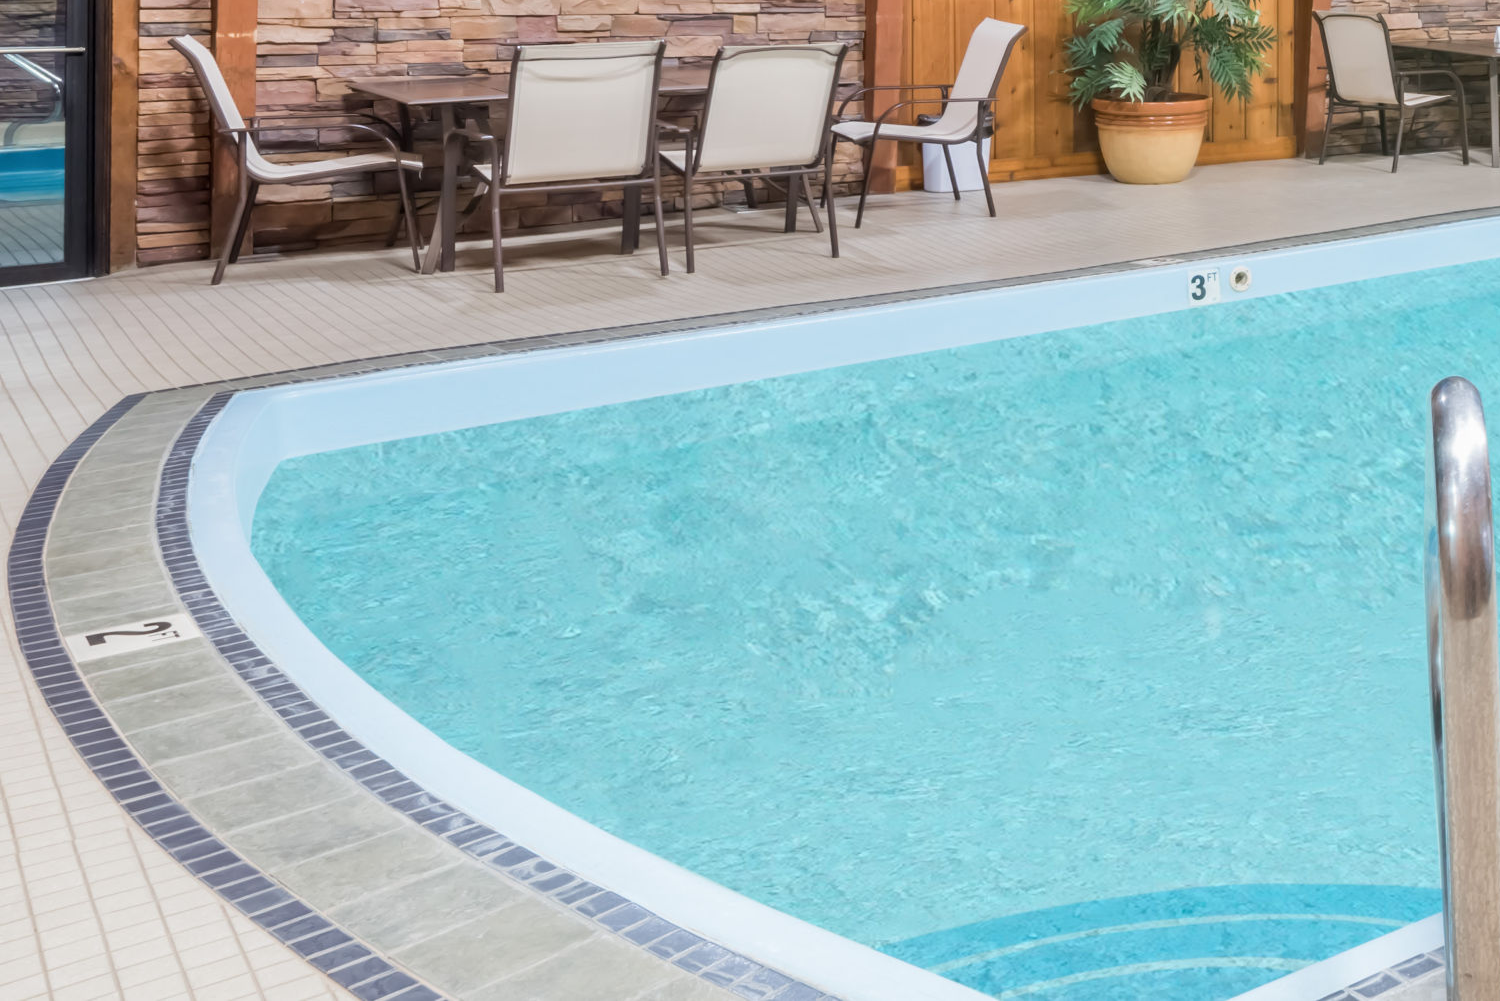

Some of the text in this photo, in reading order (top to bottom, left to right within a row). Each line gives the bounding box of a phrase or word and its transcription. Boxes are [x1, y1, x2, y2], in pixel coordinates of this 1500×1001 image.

[1191, 272, 1217, 301] 3 FT
[85, 621, 172, 647] 2
